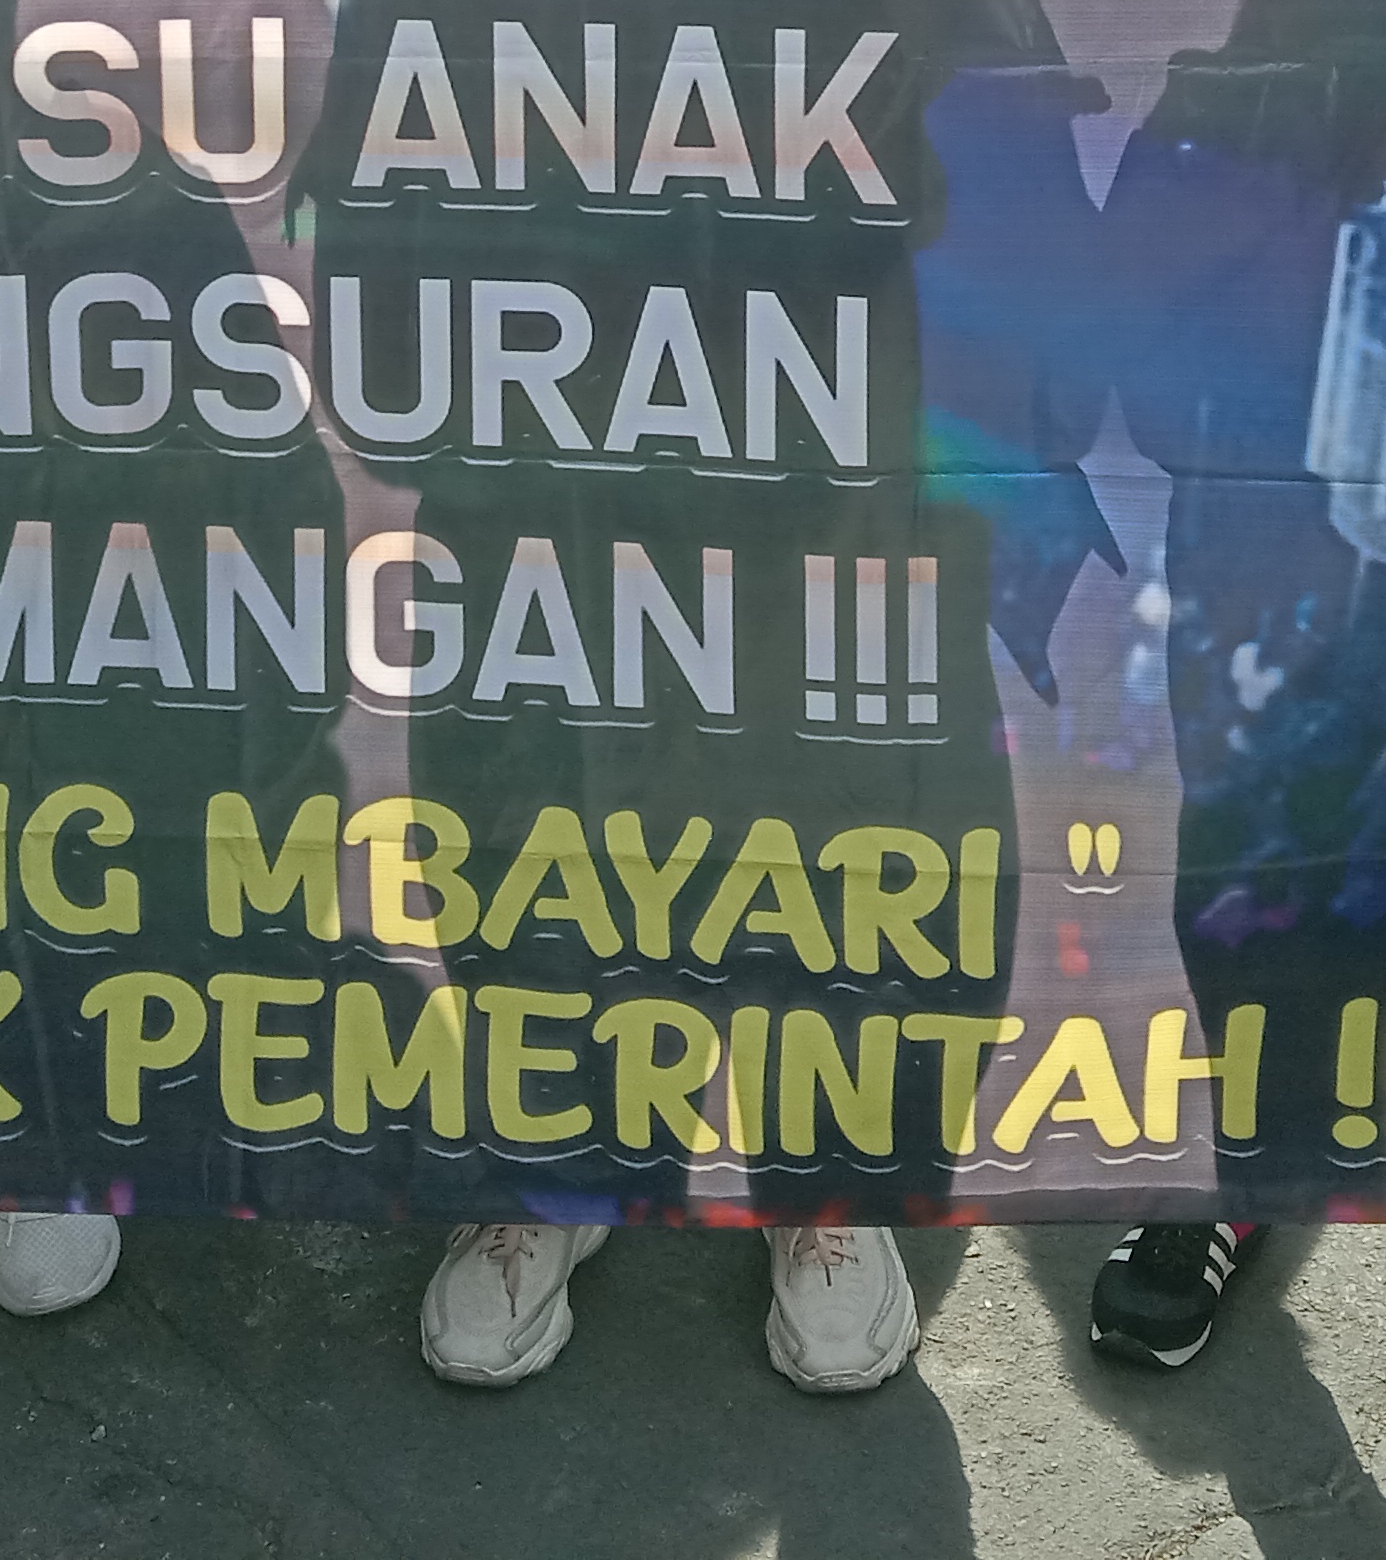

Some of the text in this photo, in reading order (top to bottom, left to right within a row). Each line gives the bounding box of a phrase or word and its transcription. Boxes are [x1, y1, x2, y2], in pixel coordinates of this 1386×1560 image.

[351, 18, 900, 207] ANAK
[206, 792, 1001, 980] MBAYARI
[80, 970, 1266, 1157] PEMERINTAH
